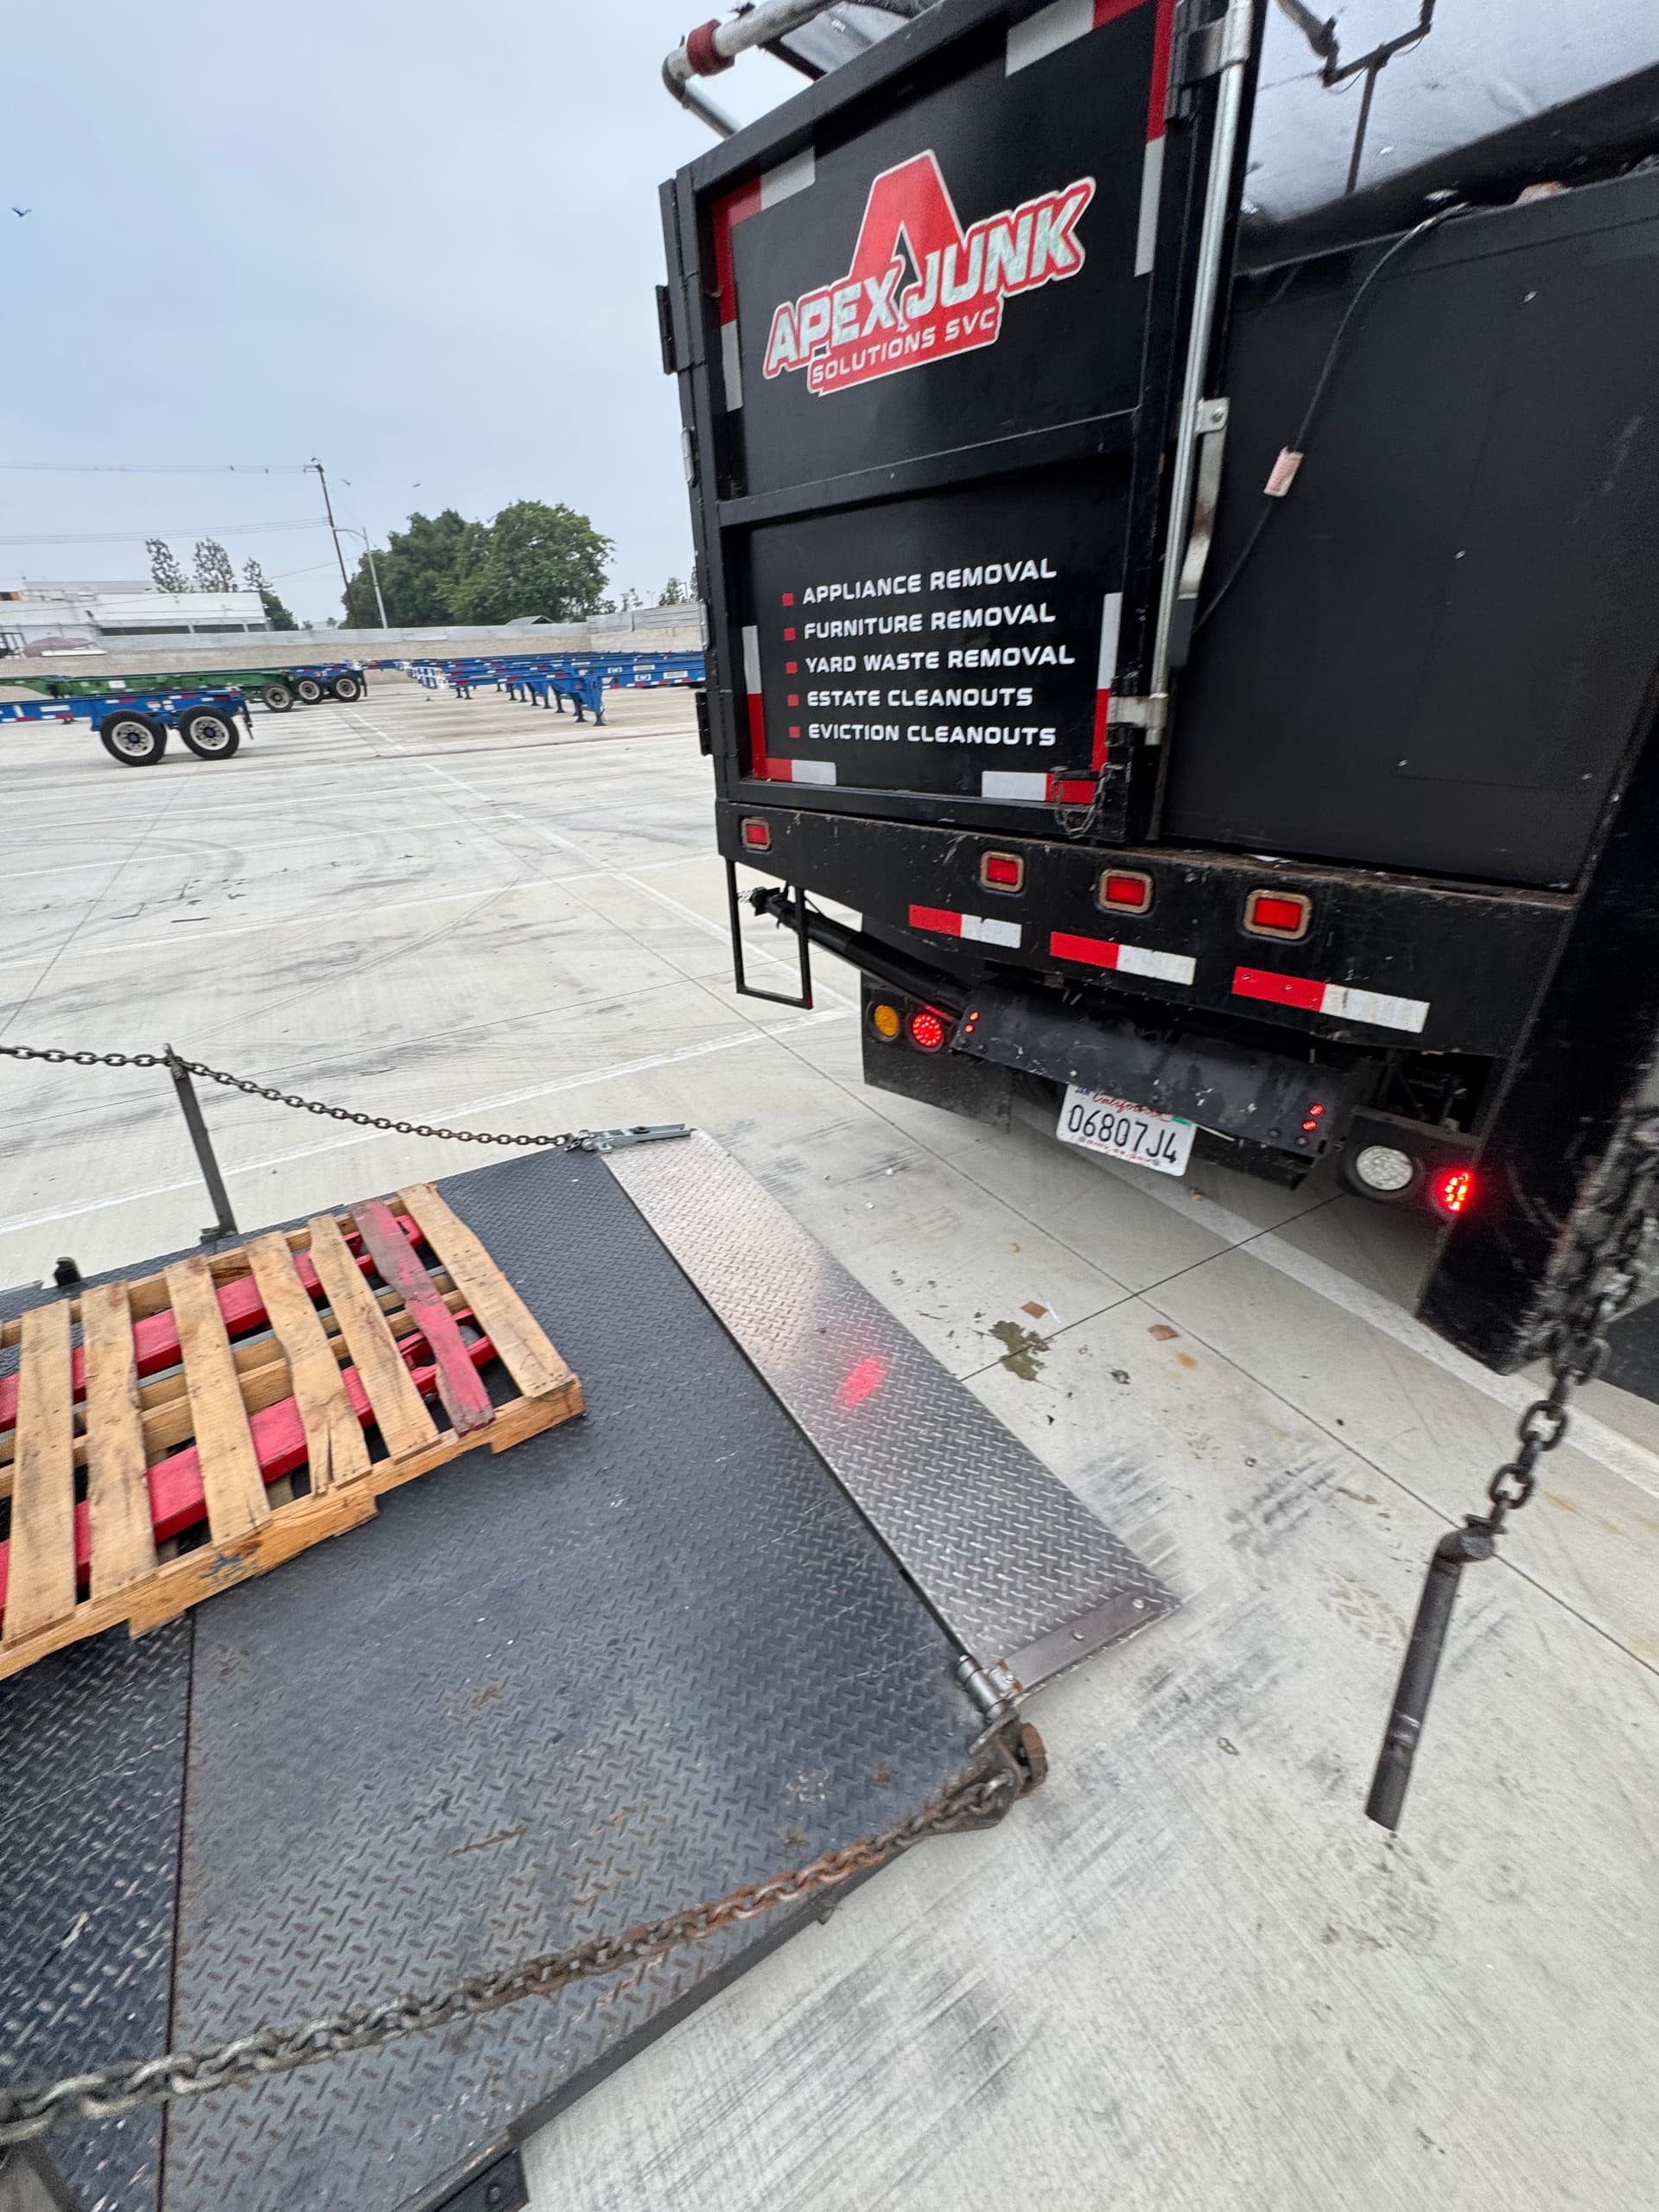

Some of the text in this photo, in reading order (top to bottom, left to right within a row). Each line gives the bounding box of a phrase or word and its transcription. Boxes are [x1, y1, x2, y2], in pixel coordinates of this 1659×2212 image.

[766, 192, 1087, 371] APEX JUNK
[811, 306, 996, 385] SOLUTIONS SVC
[802, 558, 1058, 605] APPLIANCE REMOVAL
[804, 602, 1057, 639] FURNITURE REMOVAL
[804, 645, 1076, 674] YARD WASTE REMOVAL
[807, 687, 1033, 707] ESTATE CLEANOUTS
[808, 723, 1057, 747] EVICTION CLEANOUTS
[1068, 1104, 1177, 1164] 06807J4
